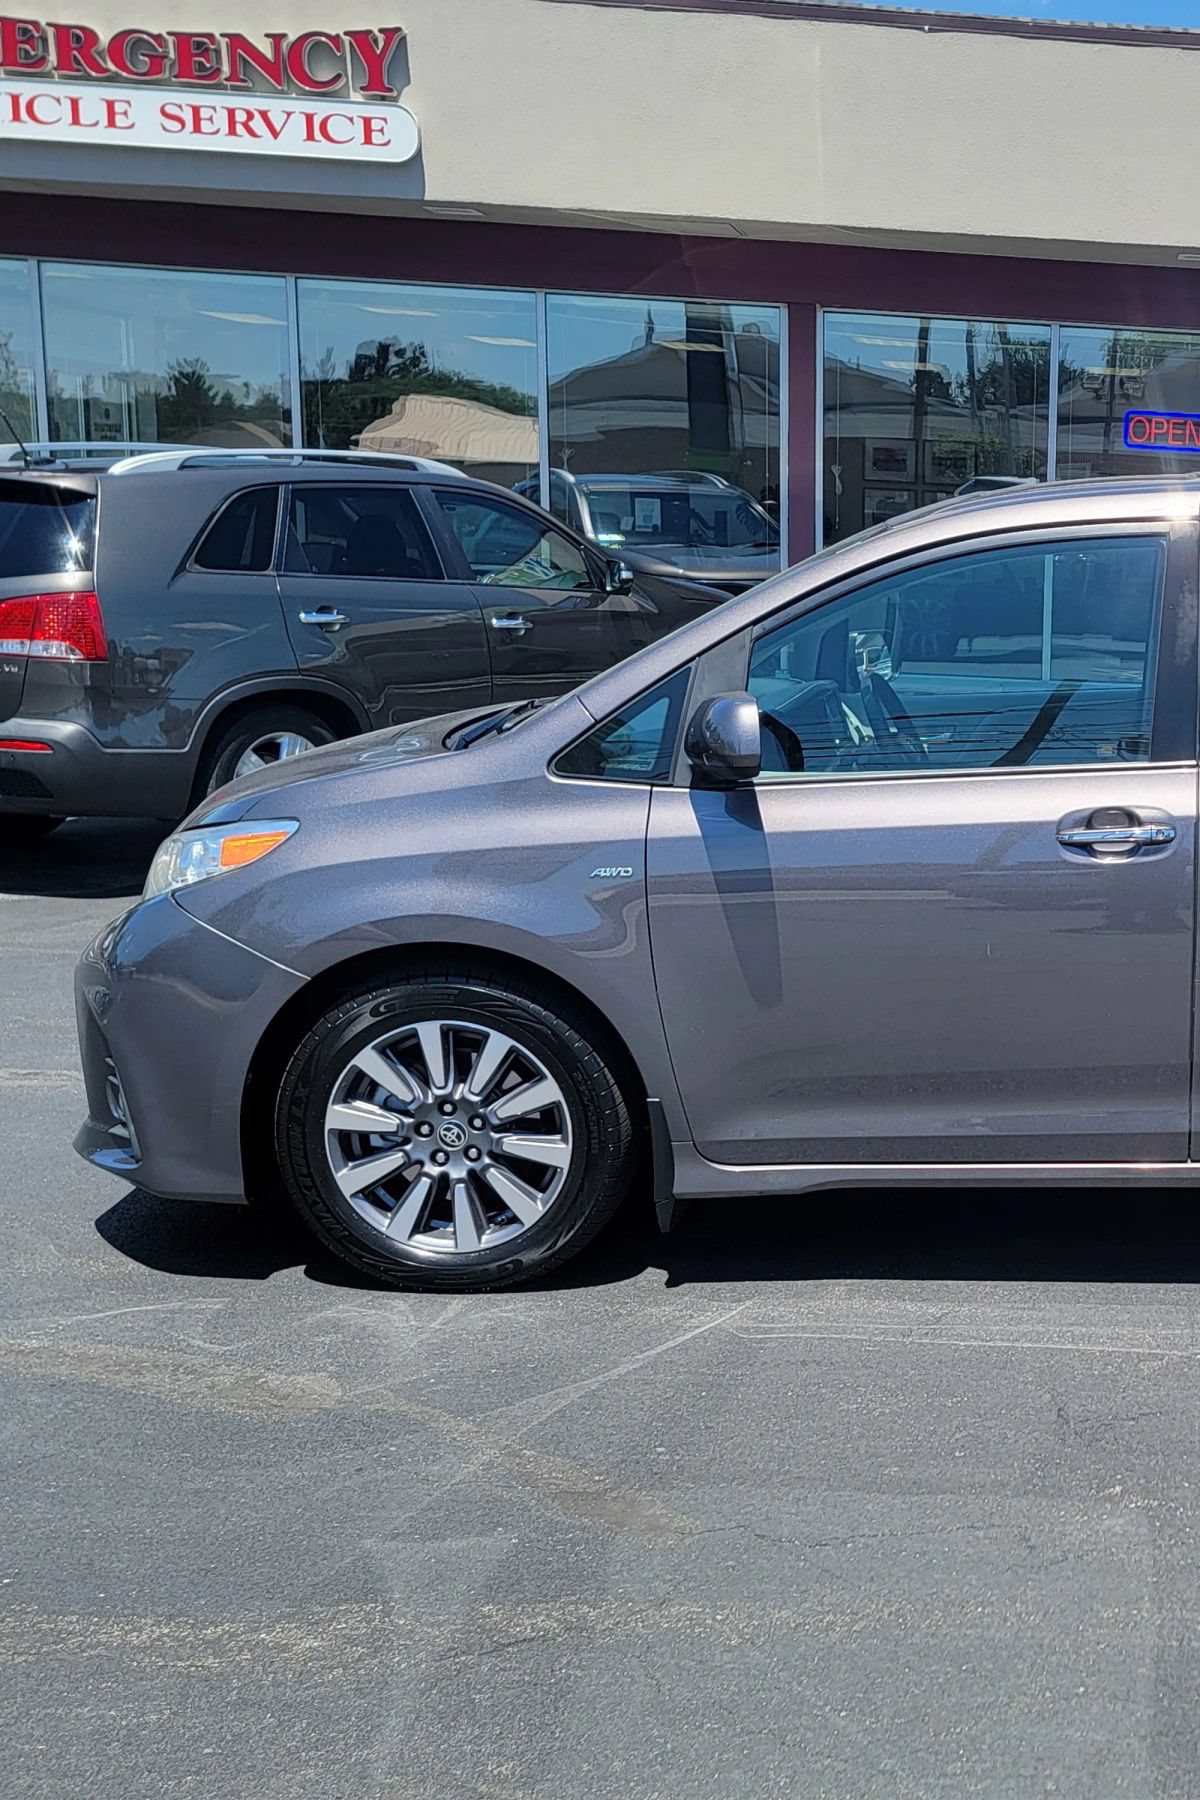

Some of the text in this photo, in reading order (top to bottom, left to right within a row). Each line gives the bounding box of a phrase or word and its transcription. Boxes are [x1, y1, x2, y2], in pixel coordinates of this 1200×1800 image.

[0, 91, 392, 147] ICLE SERVICE
[589, 866, 633, 878] AWD
